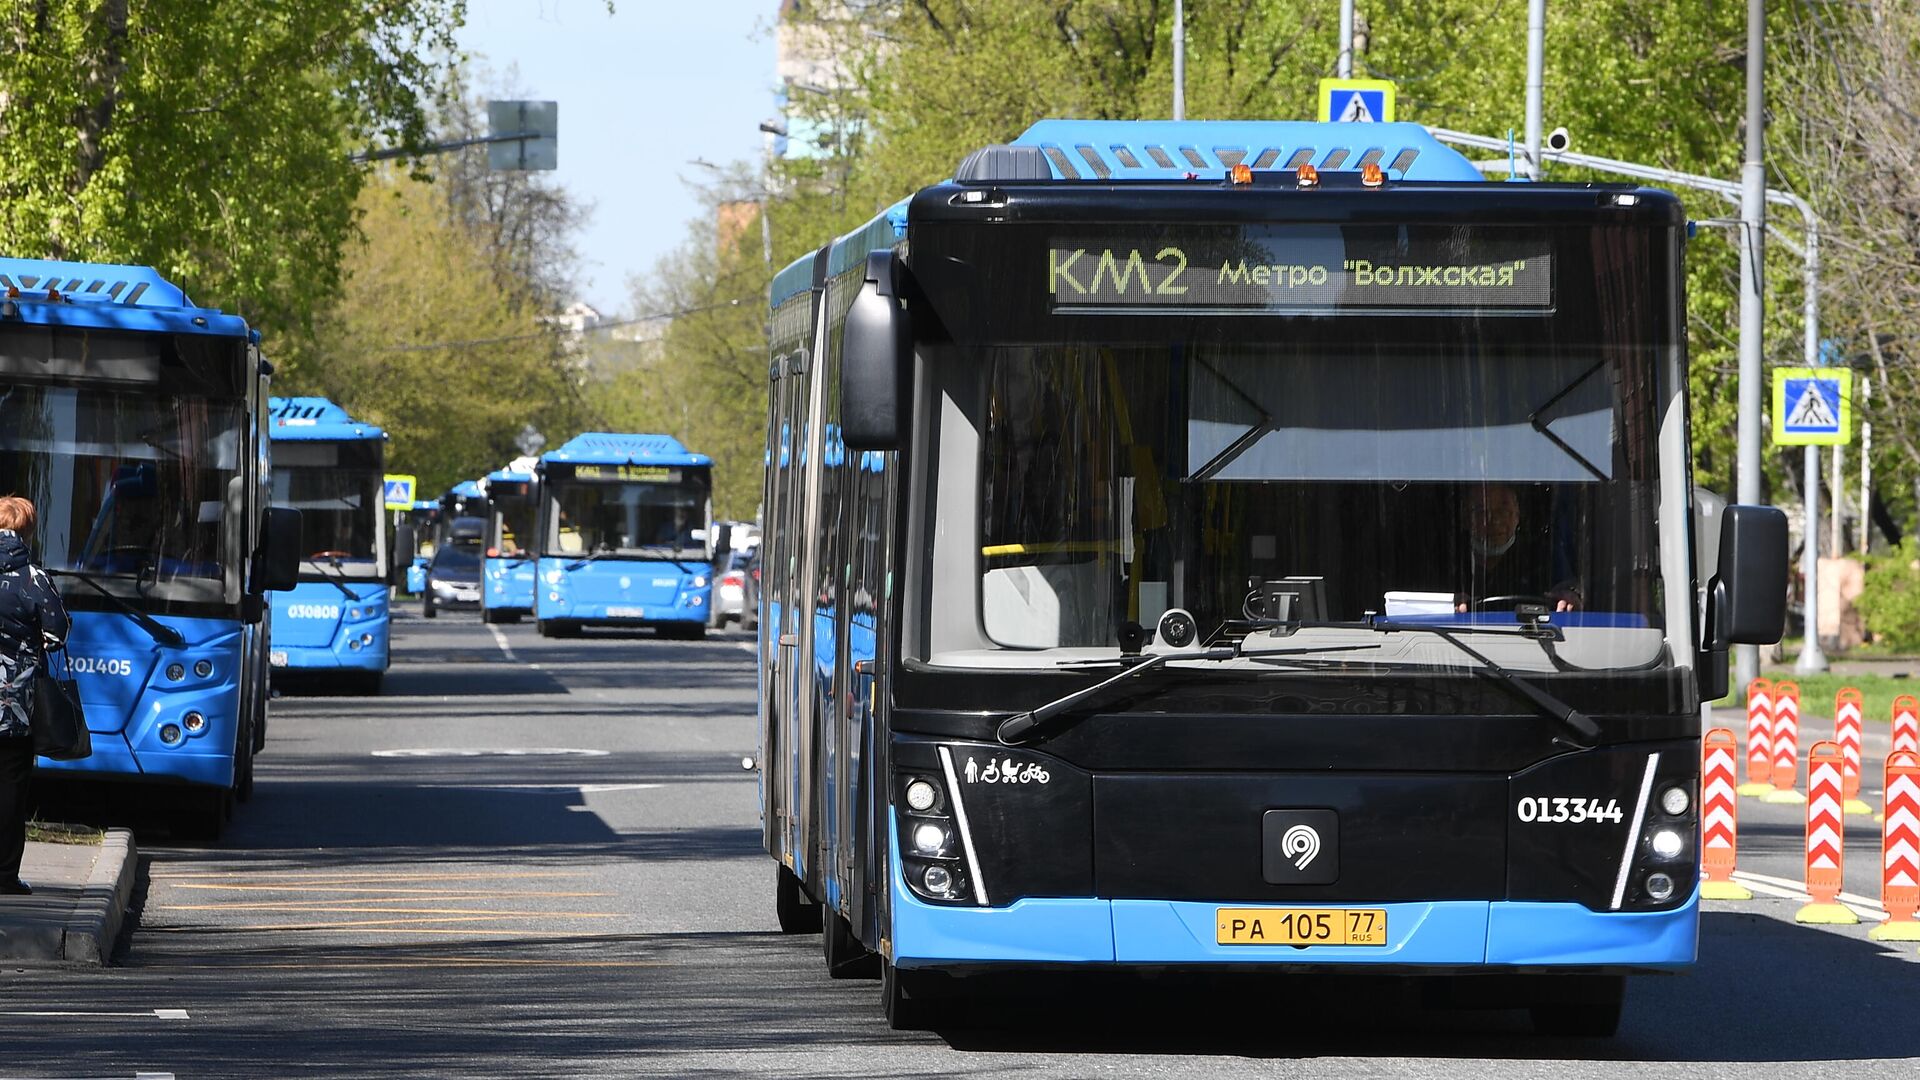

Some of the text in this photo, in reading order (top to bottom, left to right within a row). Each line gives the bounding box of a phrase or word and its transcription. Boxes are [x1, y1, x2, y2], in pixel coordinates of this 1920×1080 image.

[1217, 259, 1328, 288] Метро
[1343, 259, 1526, 286] "Волжская"
[288, 605, 338, 619] 030808
[63, 656, 132, 676] 201405
[1517, 797, 1624, 823] 013344
[1280, 913, 1331, 940] 105
[1349, 912, 1375, 933] 77
[1352, 933, 1373, 942] RUS
